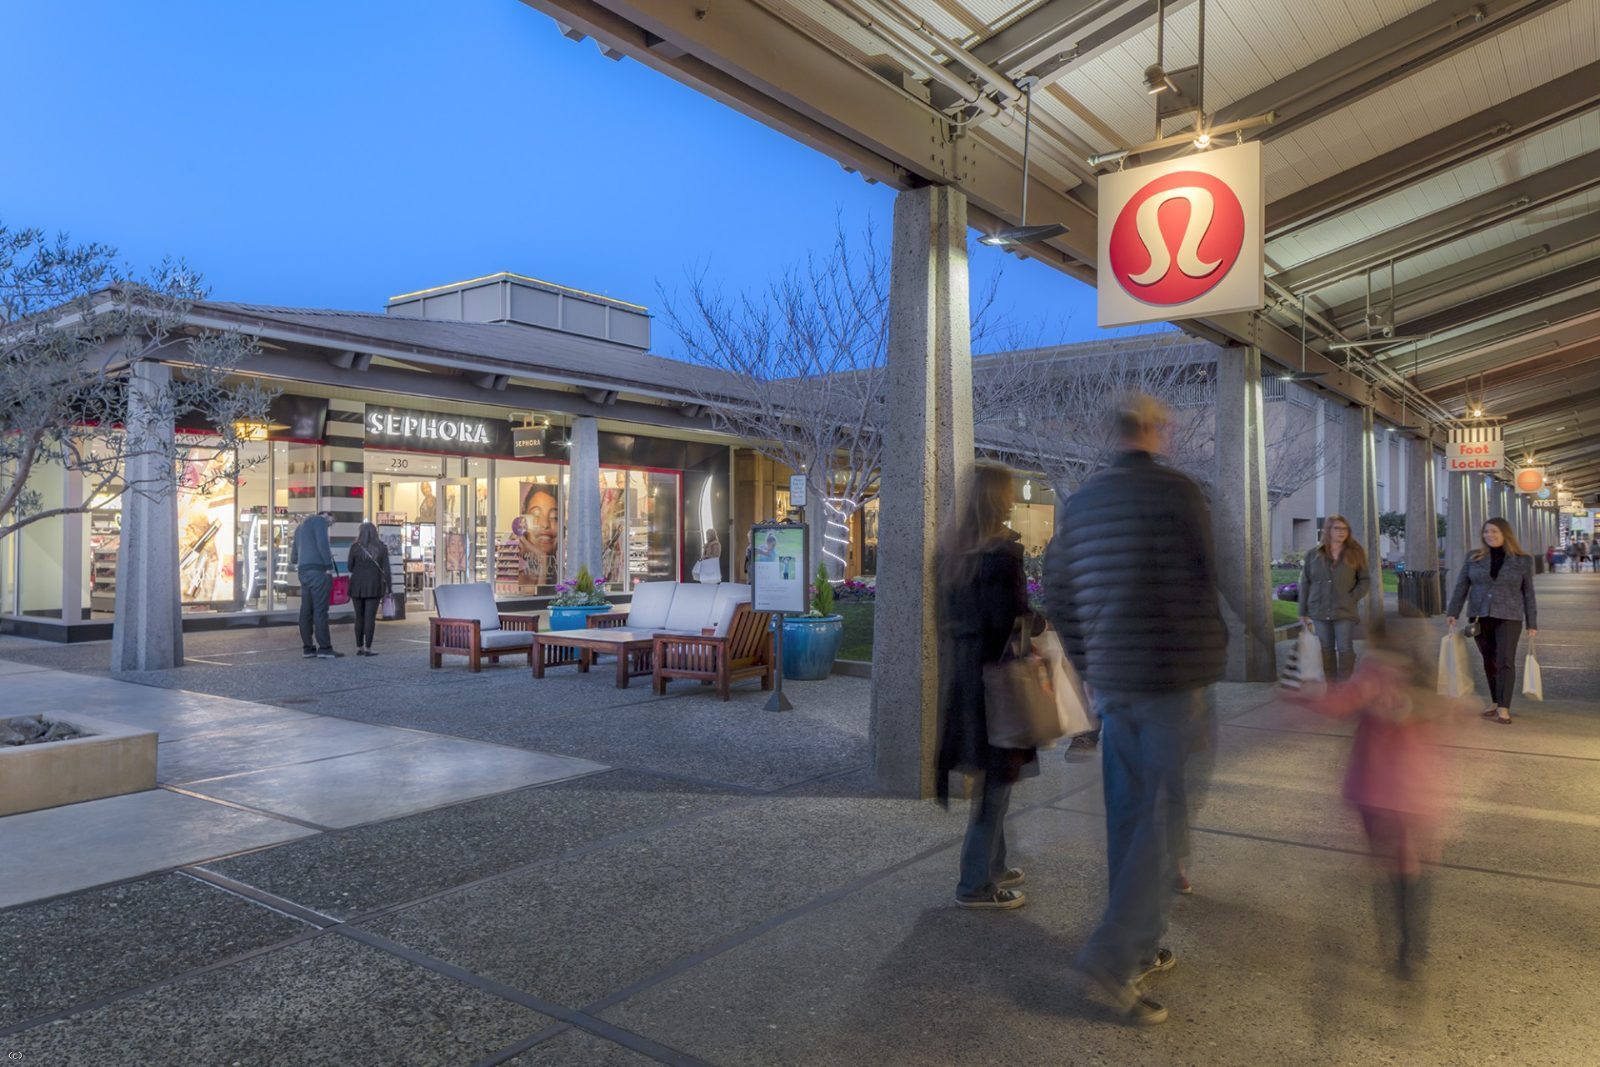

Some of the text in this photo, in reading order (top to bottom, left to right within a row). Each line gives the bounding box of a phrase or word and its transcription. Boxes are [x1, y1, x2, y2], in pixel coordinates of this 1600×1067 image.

[367, 412, 491, 444] SEPHORA
[515, 439, 541, 447] SEPHORA
[1460, 444, 1489, 455] Foot
[391, 458, 408, 469] 230
[1452, 459, 1497, 469] Locker
[1532, 499, 1556, 507] AT&T
